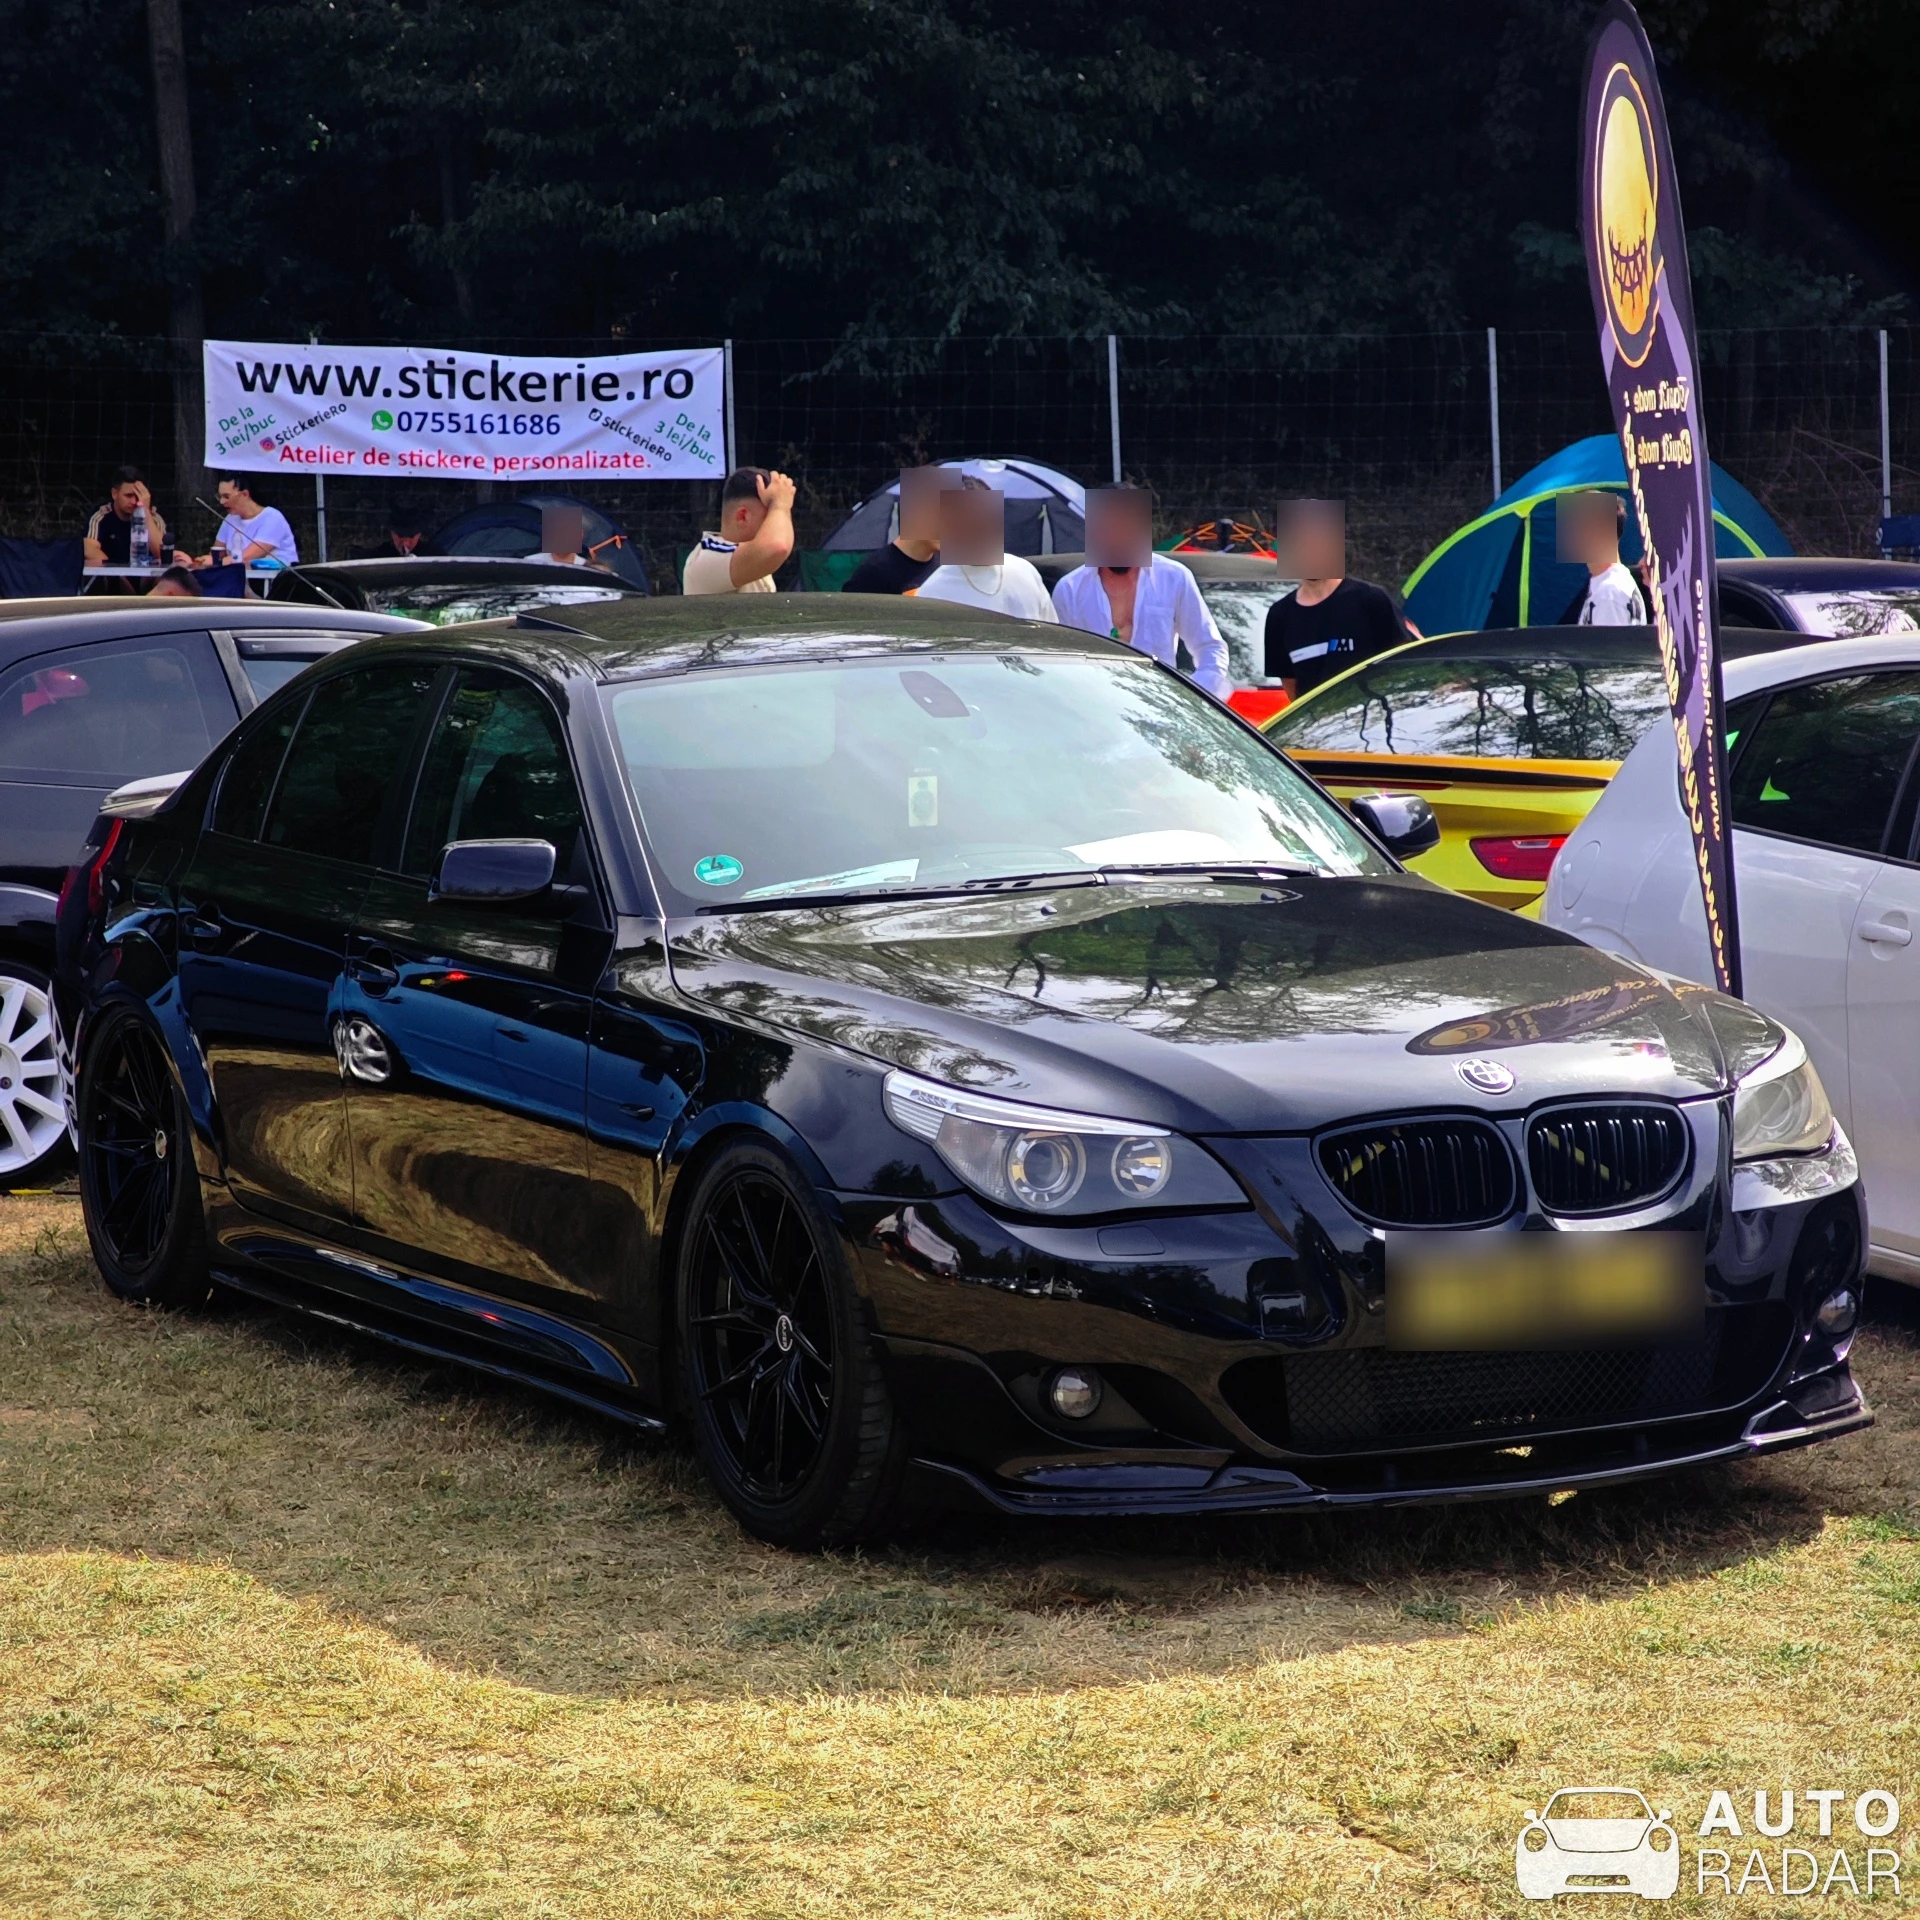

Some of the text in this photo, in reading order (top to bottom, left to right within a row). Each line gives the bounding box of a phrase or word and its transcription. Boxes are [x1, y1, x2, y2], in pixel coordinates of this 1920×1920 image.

[236, 357, 694, 402] www.stickerie.ro
[218, 406, 255, 432] De la
[397, 411, 561, 435] 0755161686
[676, 413, 712, 443] De la
[215, 414, 277, 456] 3 lei/buc
[654, 420, 717, 465] 3 lei/buc
[279, 445, 653, 475] Atelier de stickere personalizate.
